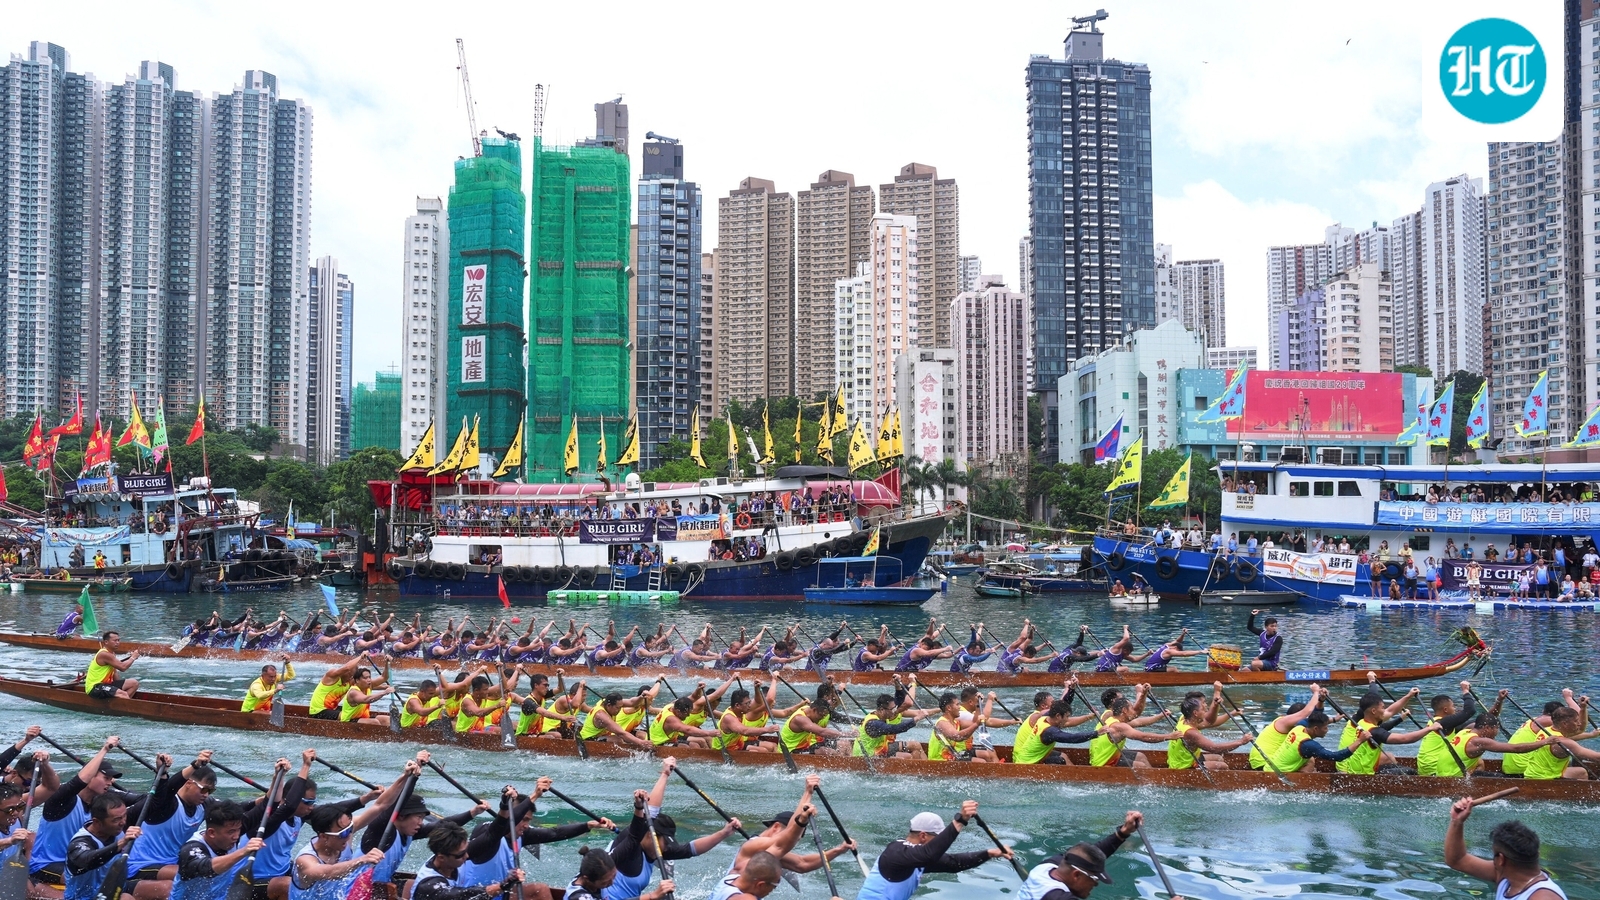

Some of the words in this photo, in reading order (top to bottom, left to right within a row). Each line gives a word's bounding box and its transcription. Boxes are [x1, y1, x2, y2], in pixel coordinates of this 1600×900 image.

[465, 283, 483, 325] 宏安
[464, 338, 482, 380] 地產
[124, 480, 145, 489] BLUE
[145, 478, 166, 487] GIRL
[588, 524, 616, 534] BLUE
[617, 524, 643, 533] GIRL
[1329, 557, 1353, 569] 超市
